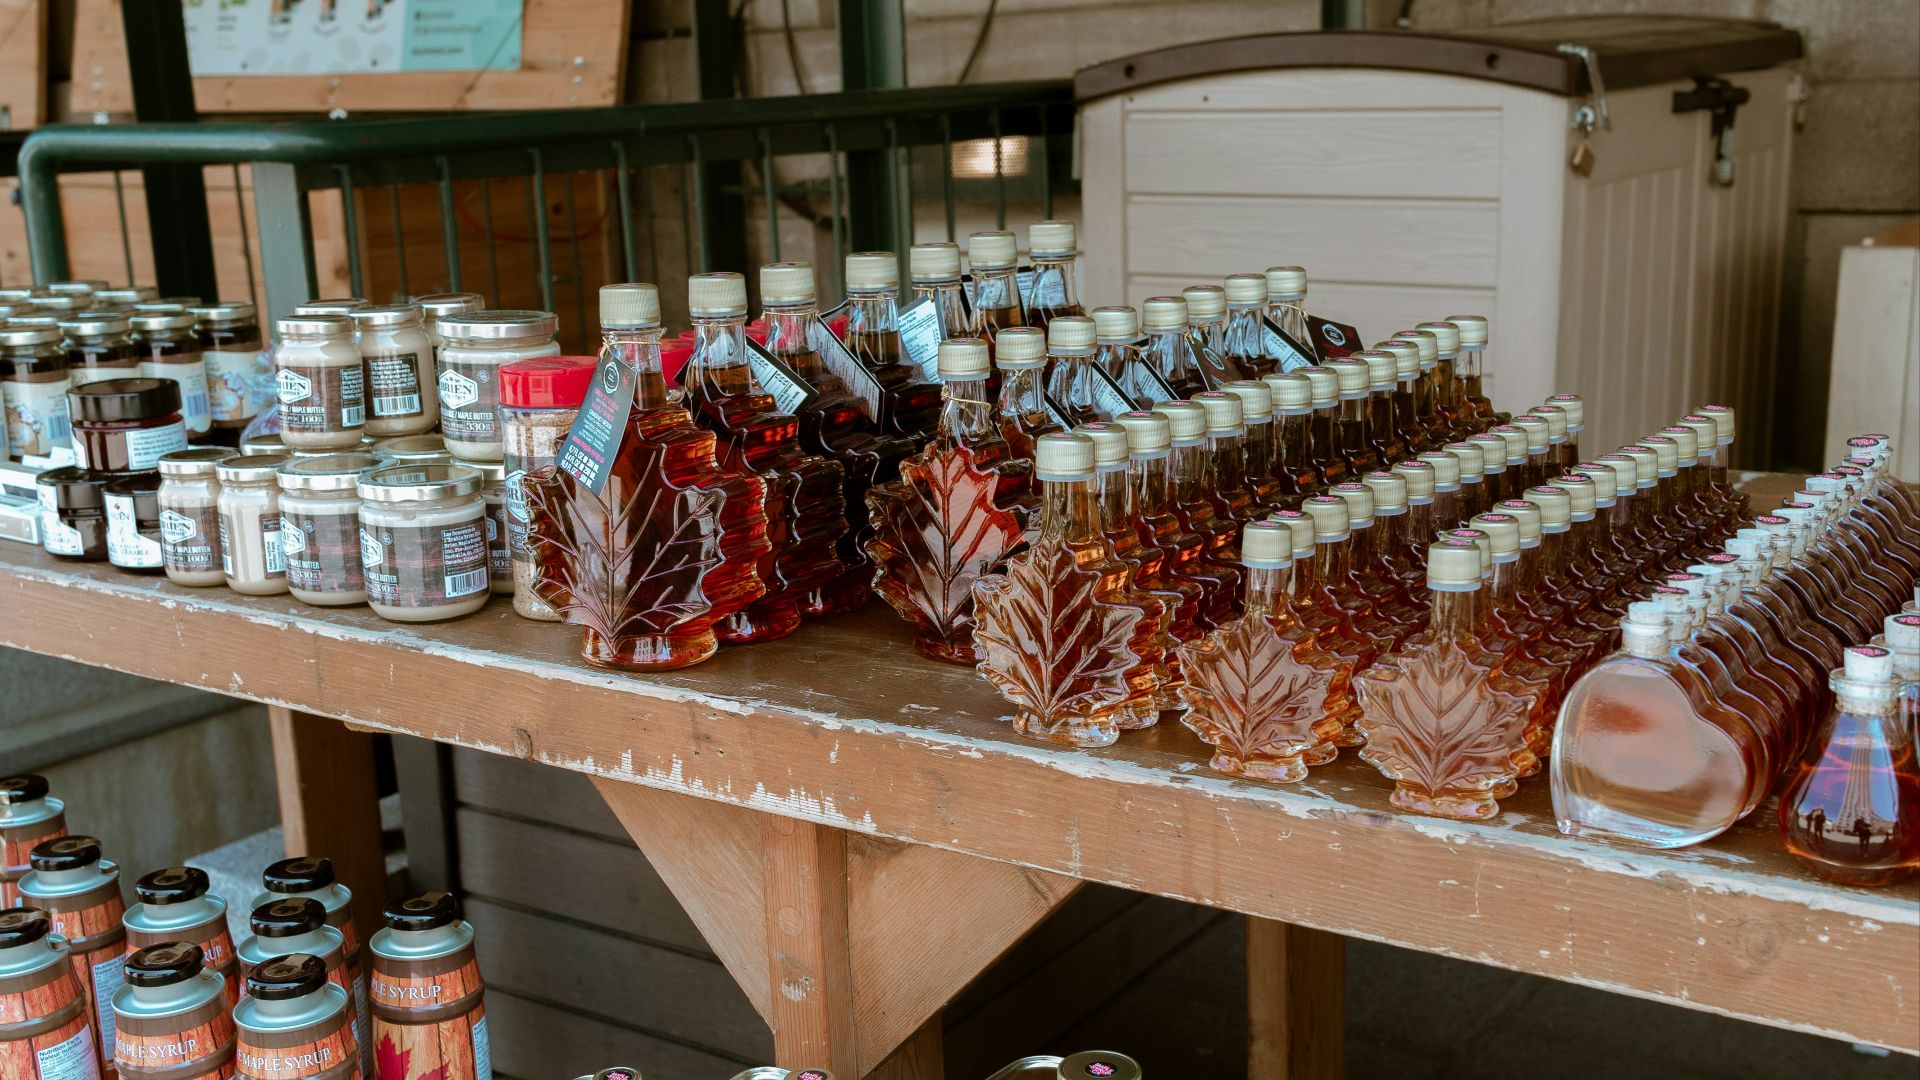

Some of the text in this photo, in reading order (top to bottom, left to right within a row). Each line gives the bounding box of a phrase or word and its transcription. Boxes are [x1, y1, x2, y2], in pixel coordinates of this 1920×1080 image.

[458, 411, 472, 420] MAPLE
[473, 412, 494, 421] BUTTER
[491, 549, 512, 557] BUTTER
[380, 574, 397, 583] BUTTER
[203, 945, 222, 962] RUP
[389, 985, 441, 999] SYRUP
[39, 1042, 66, 1058] Nutrition
[149, 1039, 197, 1059] SYRUP
[39, 1051, 57, 1062] Valeur
[243, 1055, 280, 1072] MAPLE
[285, 1047, 331, 1070] SYRUP
